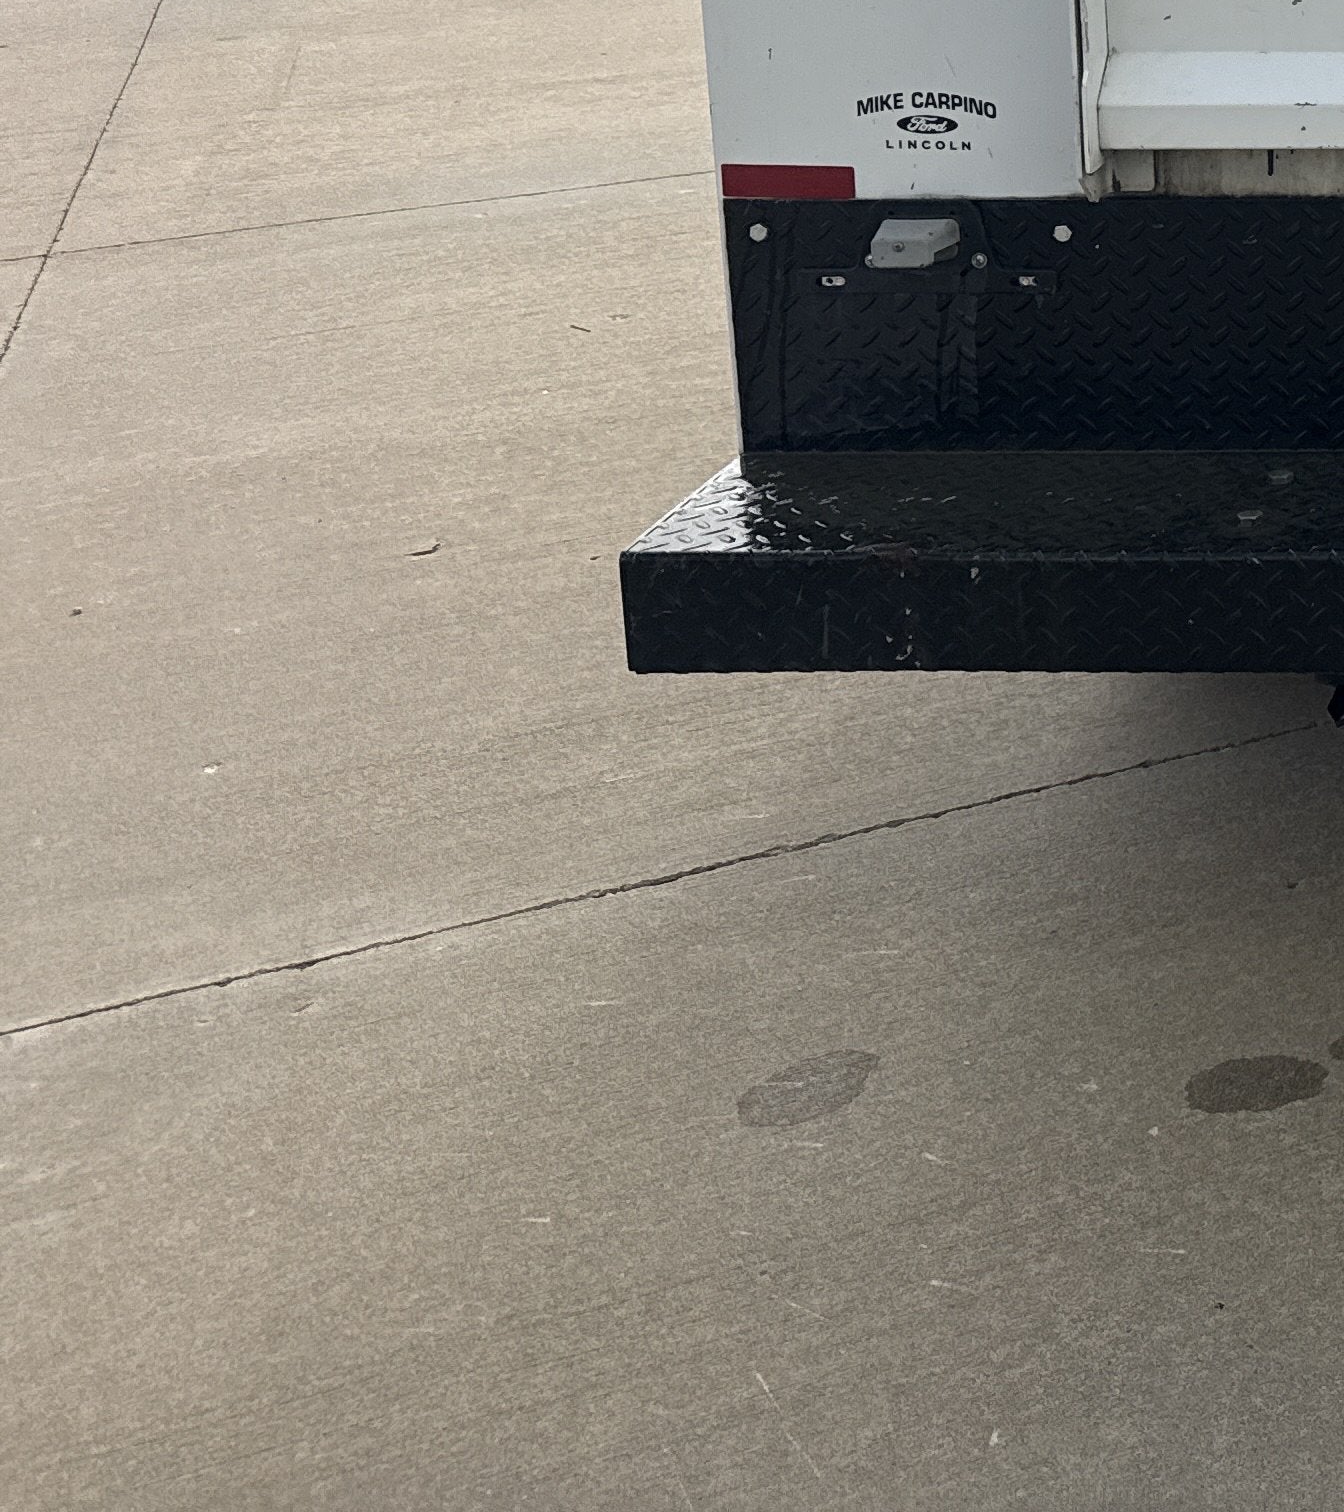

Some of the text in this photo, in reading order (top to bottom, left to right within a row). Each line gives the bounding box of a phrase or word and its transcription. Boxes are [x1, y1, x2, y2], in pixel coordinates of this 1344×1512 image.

[856, 91, 997, 119] MIKE CARPINO
[905, 115, 950, 133] Ford
[885, 139, 972, 151] LINCOLN
